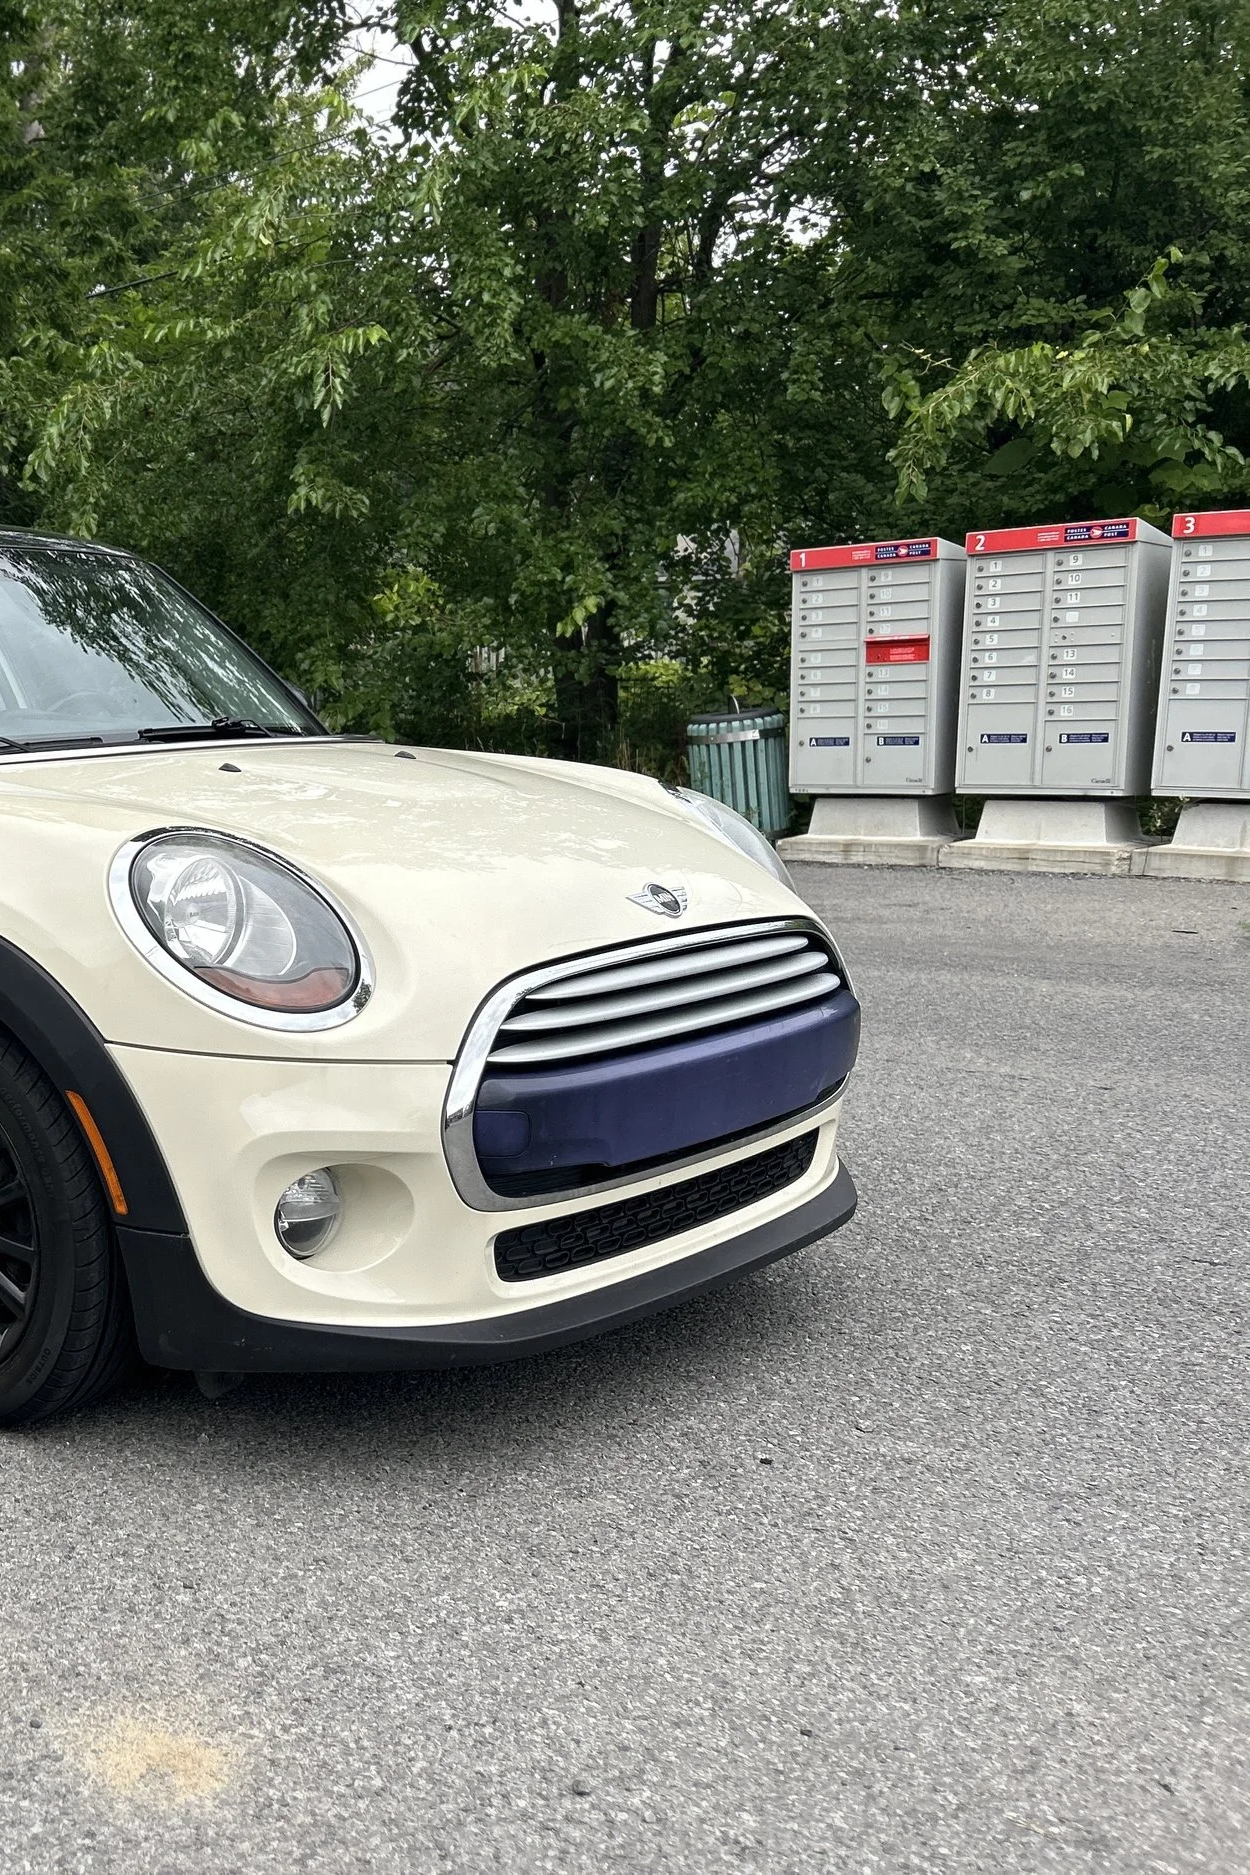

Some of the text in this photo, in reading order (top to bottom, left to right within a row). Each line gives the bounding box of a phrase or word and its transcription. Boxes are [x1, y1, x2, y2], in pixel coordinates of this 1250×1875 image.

[1183, 517, 1195, 534] 3
[974, 535, 986, 550] 2
[799, 552, 806, 568] 1
[1069, 574, 1080, 582] 10
[1068, 593, 1078, 601] 11
[1065, 650, 1076, 658] 13
[1064, 668, 1074, 676] 14
[1063, 688, 1074, 696] 15
[1062, 706, 1072, 714] 16
[1061, 734, 1068, 742] B
[1183, 733, 1191, 742] A
[810, 738, 816, 746] A
